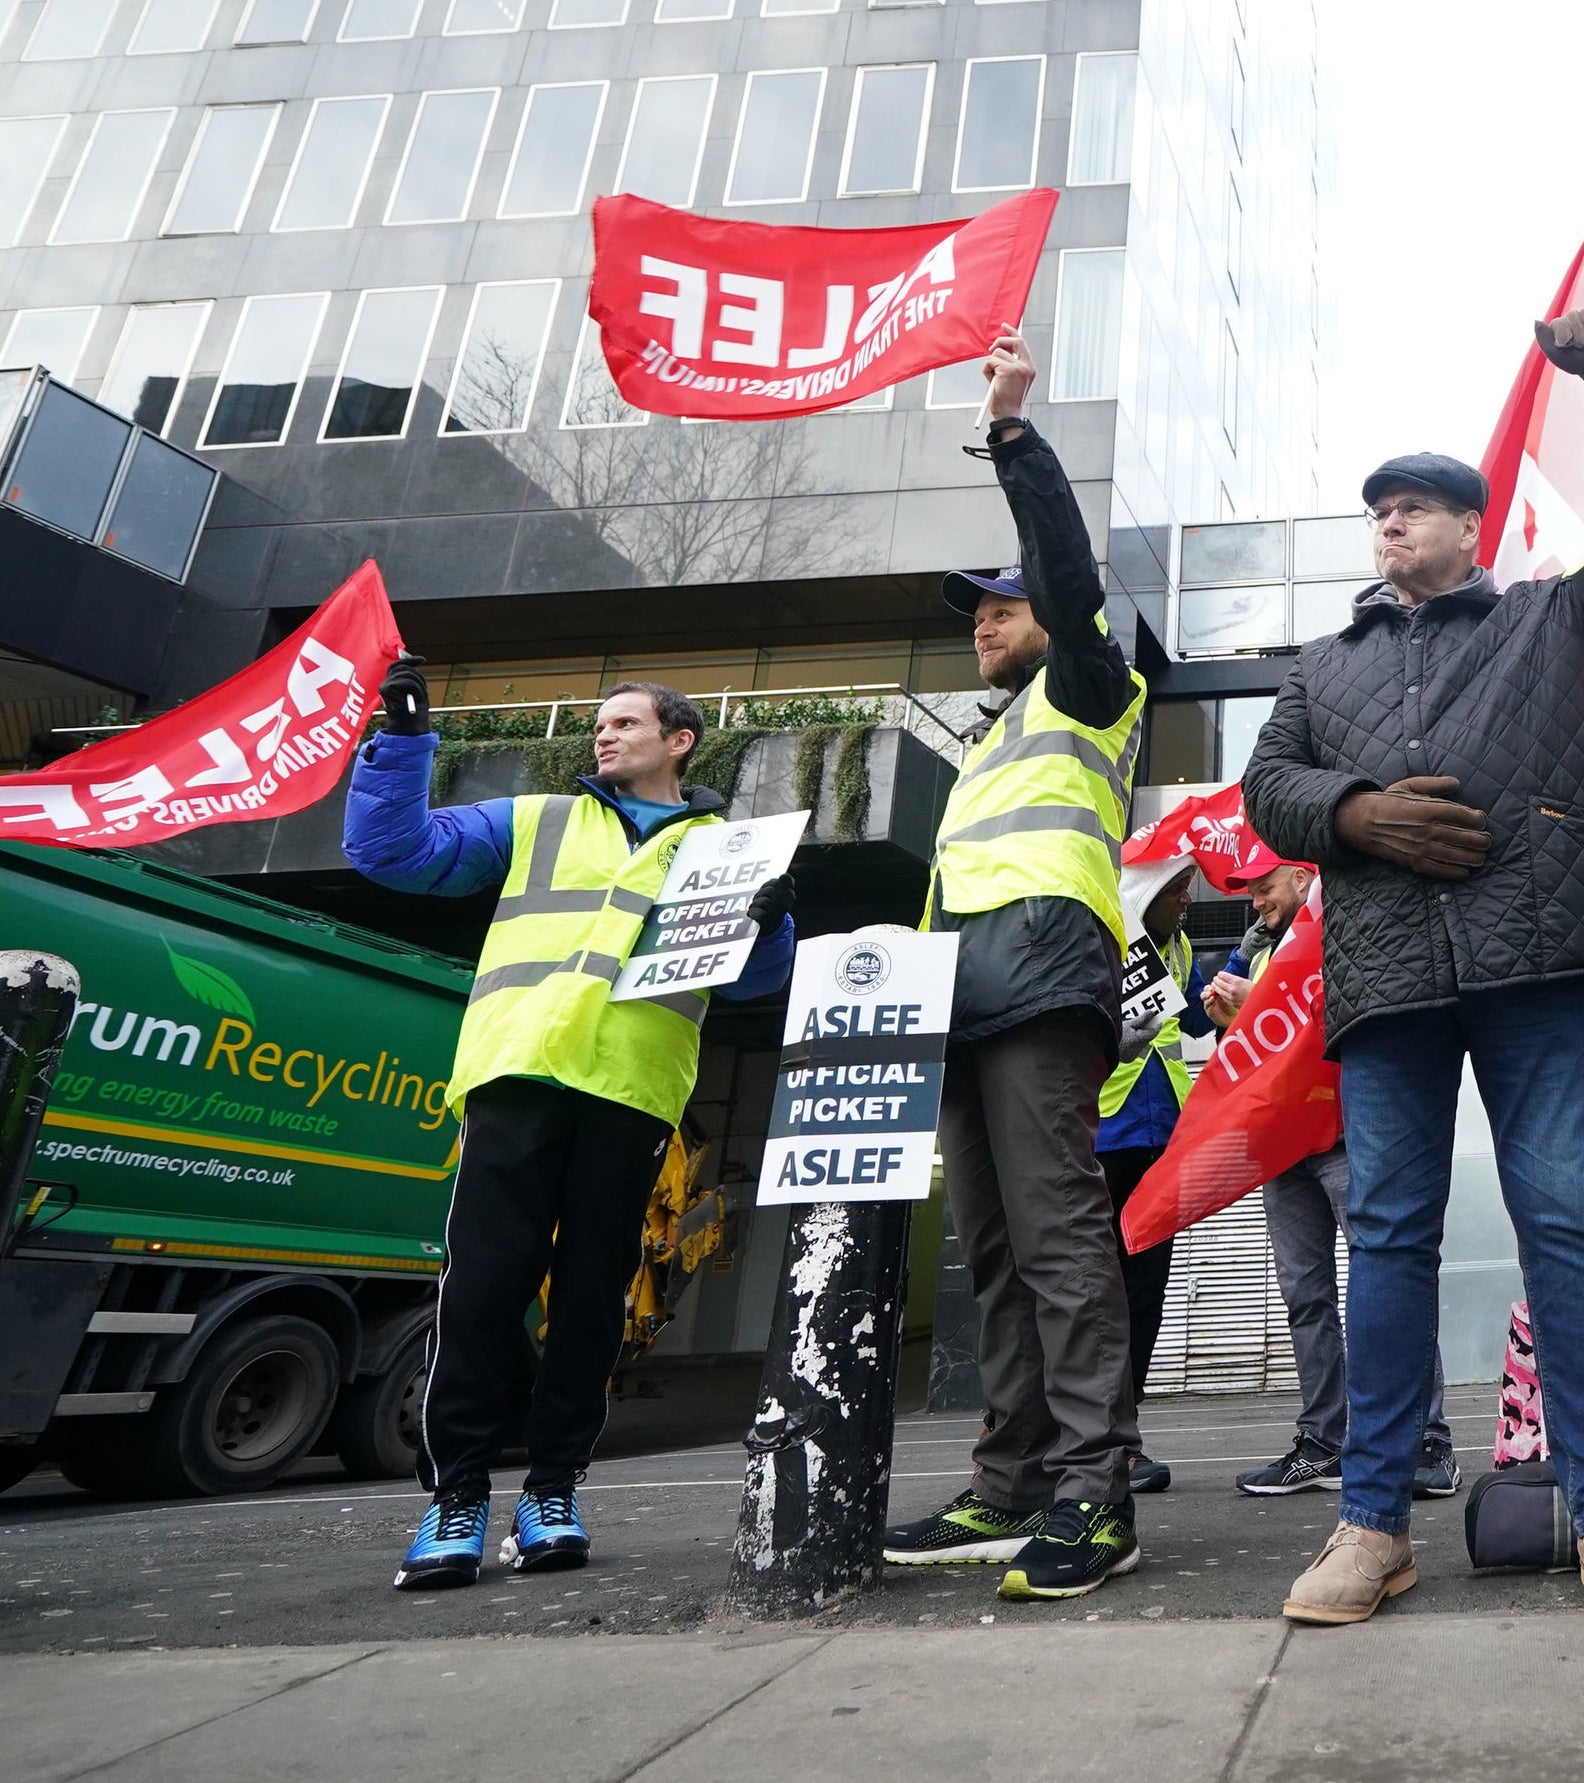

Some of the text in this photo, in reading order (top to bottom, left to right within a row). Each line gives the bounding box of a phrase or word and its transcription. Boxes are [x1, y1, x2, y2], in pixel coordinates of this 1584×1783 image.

[677, 859, 772, 893] ASLEF
[657, 896, 753, 924] OFFICIA
[655, 918, 745, 946] PICKET
[633, 951, 730, 988] ASLEF
[801, 1004, 922, 1041] ASLEF
[205, 1017, 448, 1130] Recycling
[786, 1063, 926, 1089] OFFICIAL
[98, 1080, 200, 1119] energy
[191, 1091, 264, 1125] from
[270, 1108, 338, 1137] waste
[788, 1096, 908, 1124] PICKET
[36, 1139, 296, 1187] .spectrumrecycling.co.uk
[777, 1147, 905, 1188] ASLEF
